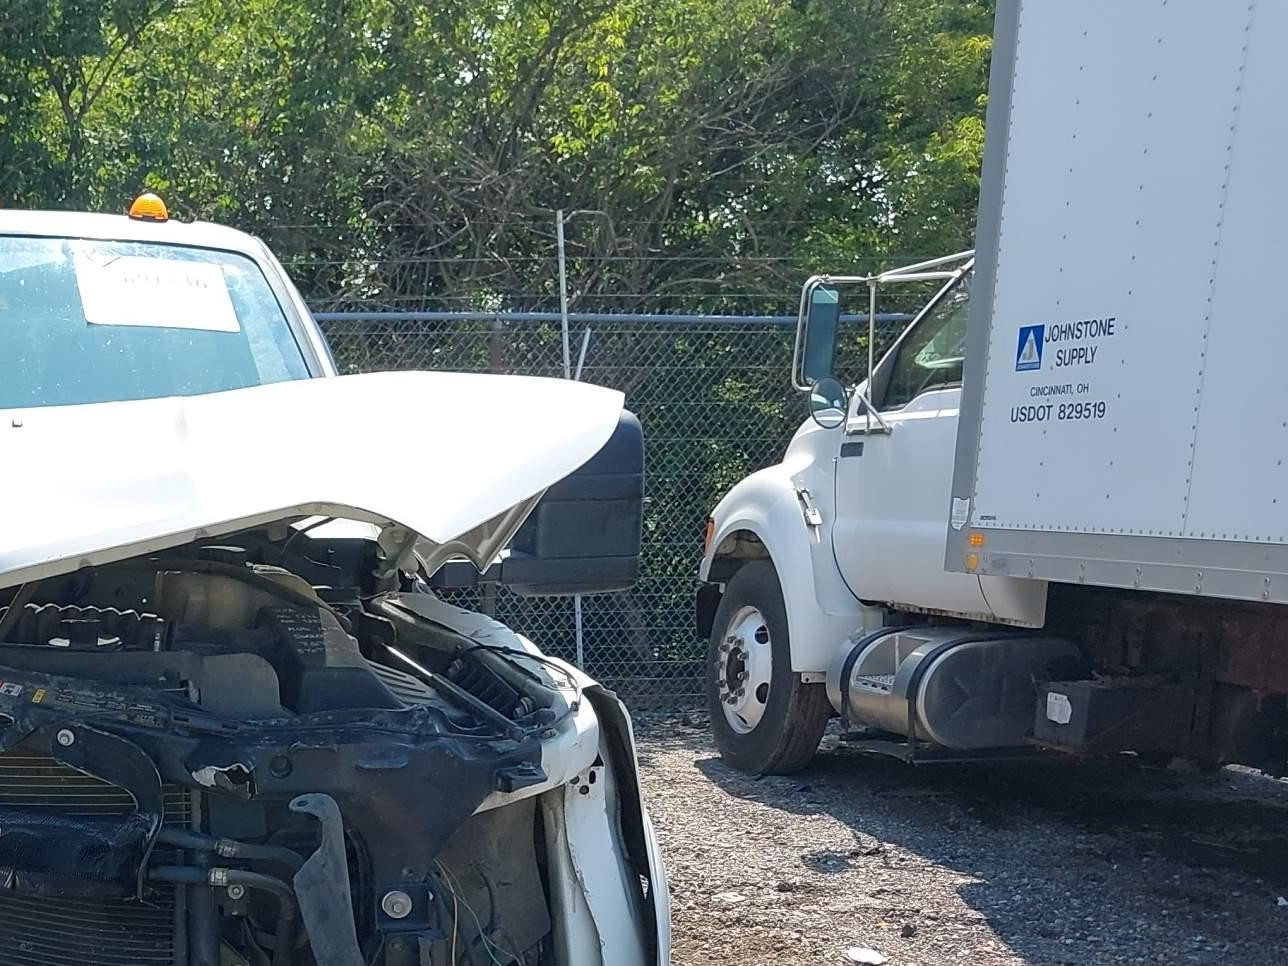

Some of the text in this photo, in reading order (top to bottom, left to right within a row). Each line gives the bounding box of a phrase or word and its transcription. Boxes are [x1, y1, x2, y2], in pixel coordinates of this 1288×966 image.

[1044, 319, 1115, 343] JOHNSTONE
[1055, 346, 1098, 367] SUPPLY
[1030, 383, 1090, 398] CINCINNATI, OH
[1010, 401, 1106, 423] USDOT 829519
